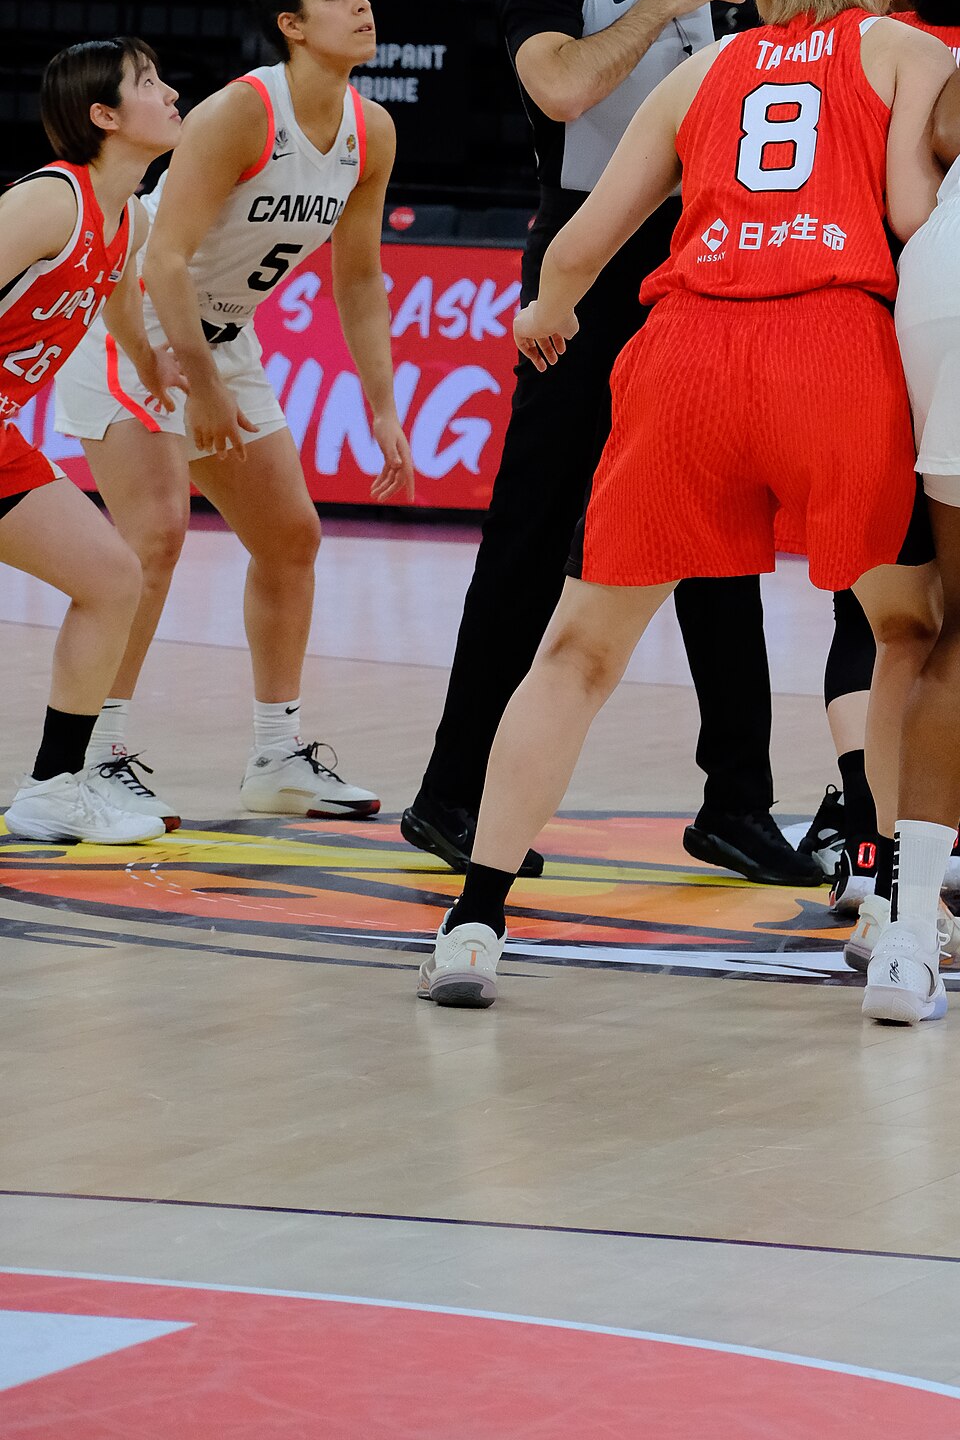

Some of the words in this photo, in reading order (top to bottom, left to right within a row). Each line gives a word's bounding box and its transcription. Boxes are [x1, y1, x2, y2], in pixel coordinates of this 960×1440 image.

[735, 81, 822, 192] 8
[738, 213, 847, 251] 日本生命
[247, 243, 303, 291] 5
[3, 340, 63, 384] 26
